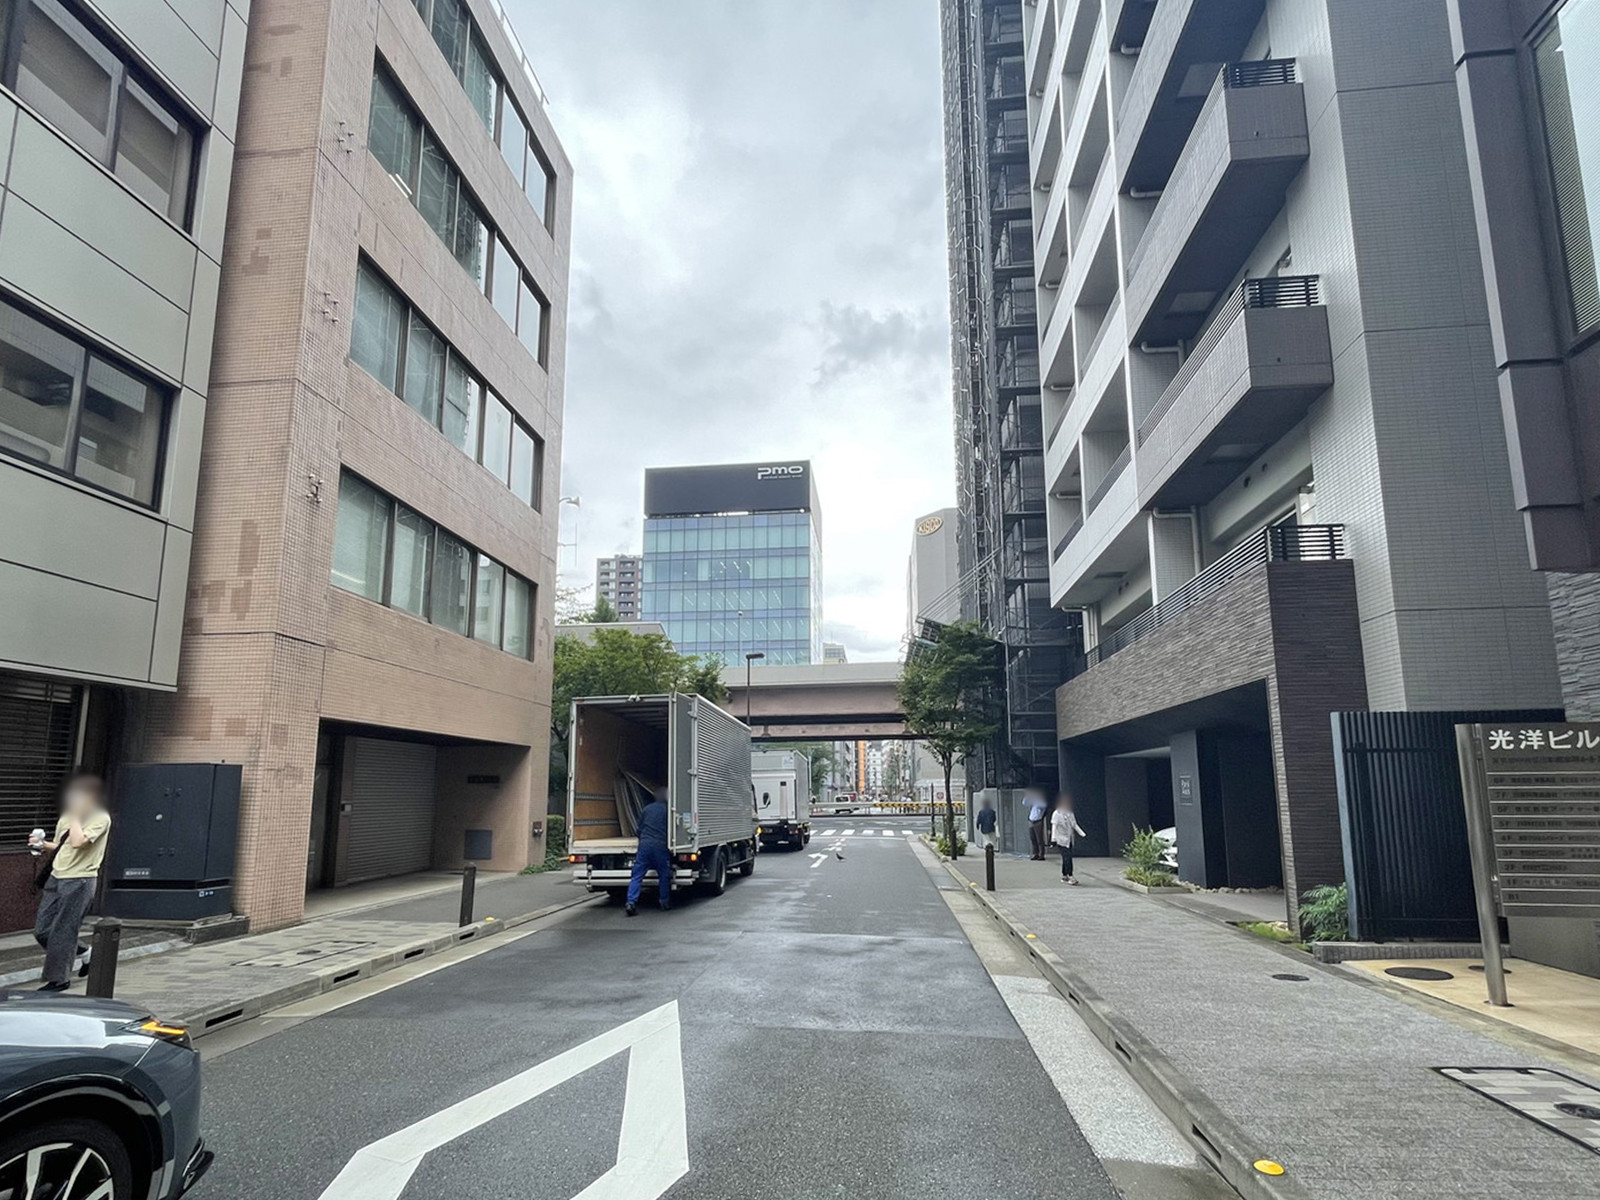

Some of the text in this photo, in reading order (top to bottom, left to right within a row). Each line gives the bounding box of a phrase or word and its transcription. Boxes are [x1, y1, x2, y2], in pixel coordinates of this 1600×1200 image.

[757, 465, 804, 480] pmo
[1488, 729, 1600, 750] 光洋ビル
